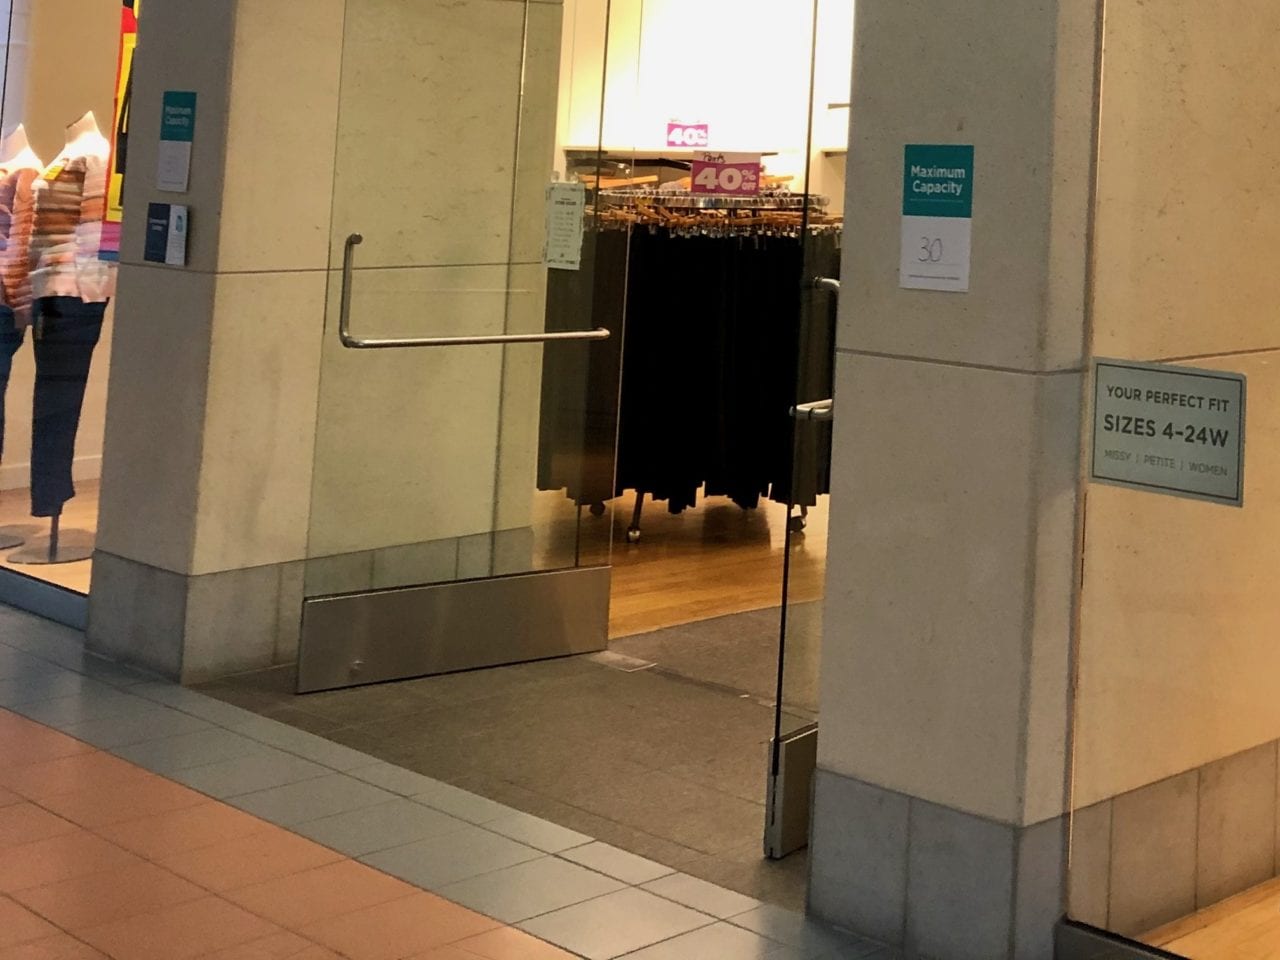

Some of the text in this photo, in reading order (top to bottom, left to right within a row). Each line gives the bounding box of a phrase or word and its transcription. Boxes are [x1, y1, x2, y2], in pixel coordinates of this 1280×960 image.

[910, 165, 966, 178] Maximum
[741, 182, 756, 190] OFF
[912, 180, 962, 196] Capacity
[918, 236, 943, 262] 30
[1106, 385, 1229, 412] YOUR PERFECT FIT
[1103, 414, 1229, 447] SIZES 4-24W
[1104, 449, 1228, 476] MISSY PETITE WOMEN
